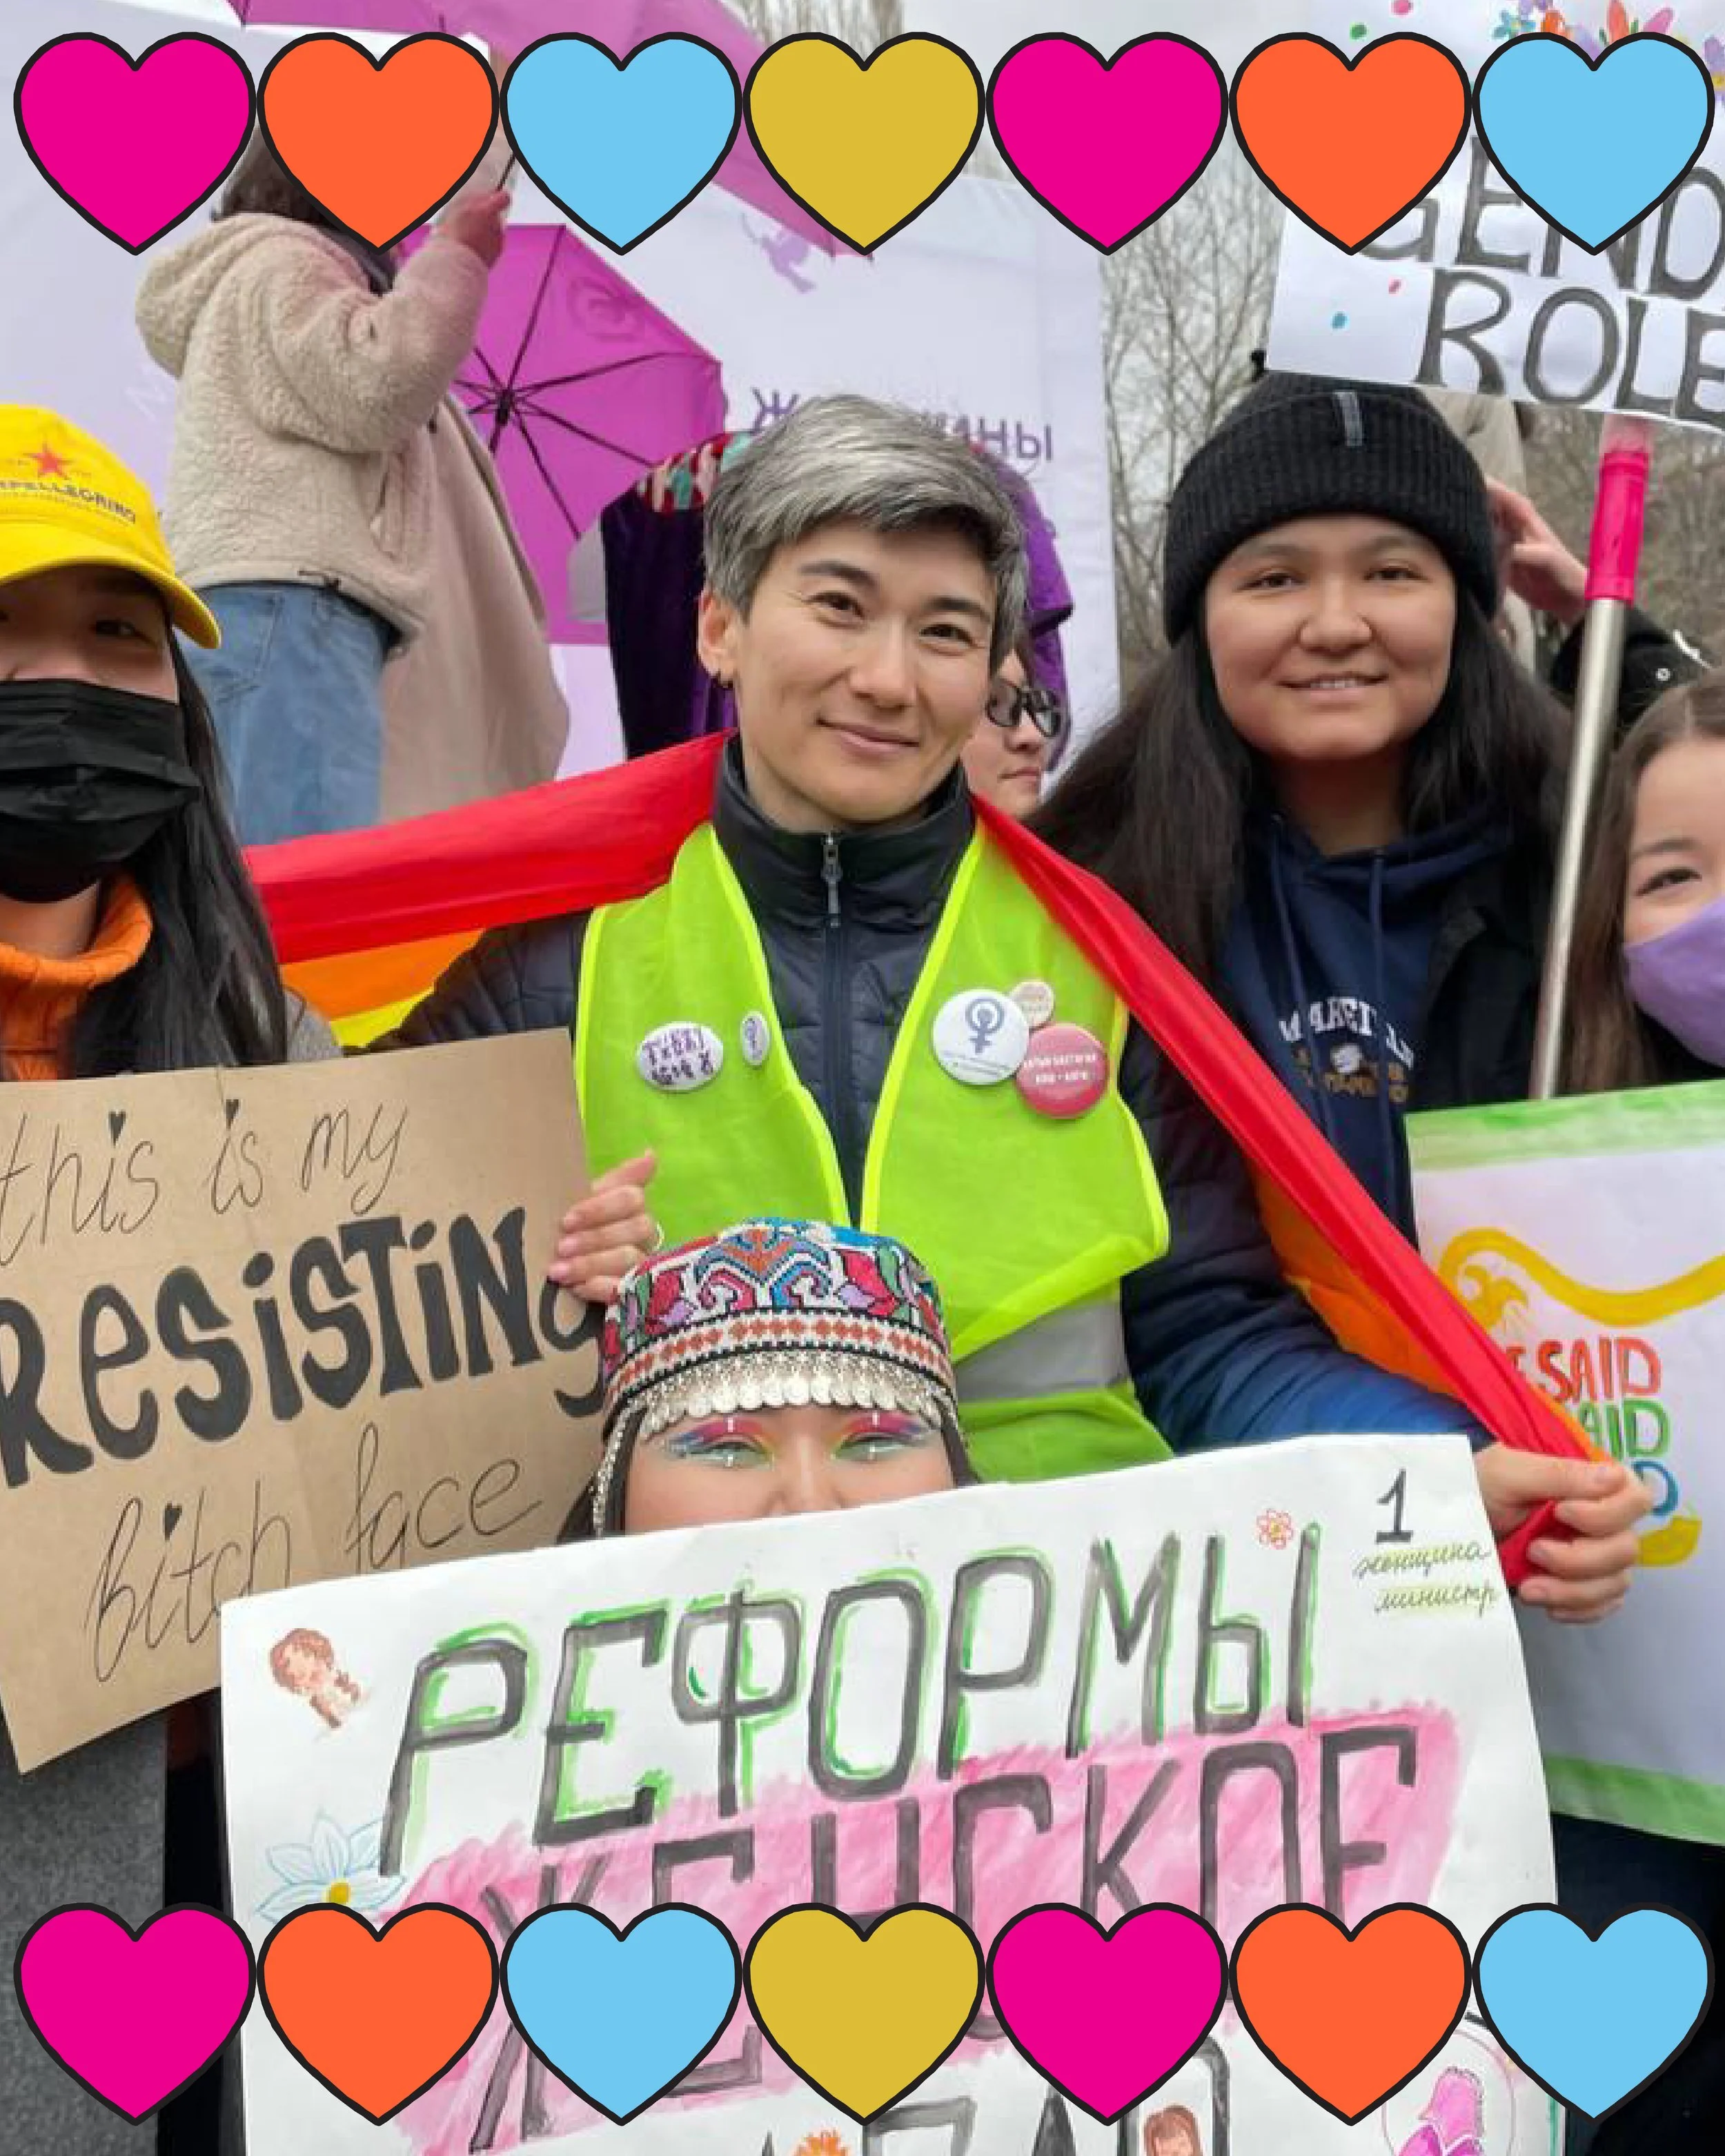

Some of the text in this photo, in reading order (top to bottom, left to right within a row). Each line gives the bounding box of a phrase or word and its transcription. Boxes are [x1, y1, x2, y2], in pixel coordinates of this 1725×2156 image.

[751, 386, 1053, 461] Жины
[0, 1098, 409, 1267] this is my
[1536, 1335, 1662, 1404] SAID
[1375, 1467, 1413, 1544] 1
[84, 1421, 543, 1682] bitch face
[1351, 1540, 1492, 1580] женщина
[378, 1521, 1321, 1878] РЕФОРМЫ
